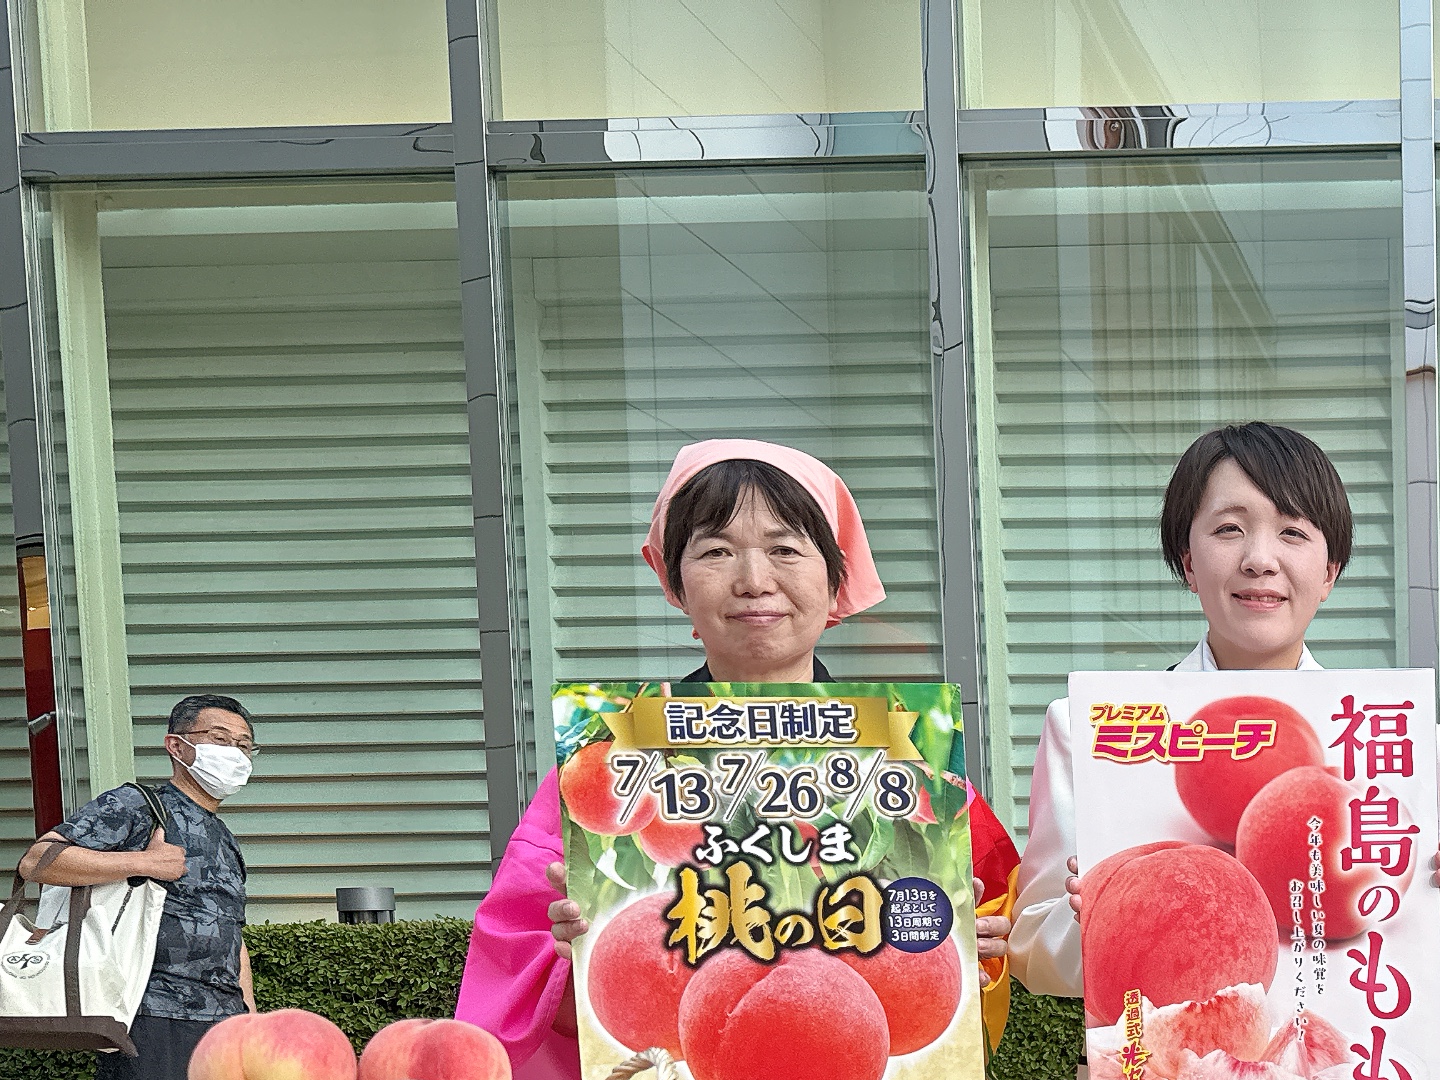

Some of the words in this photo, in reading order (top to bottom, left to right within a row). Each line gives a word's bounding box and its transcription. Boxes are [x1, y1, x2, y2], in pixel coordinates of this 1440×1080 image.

[667, 701, 858, 742] 記念日制定
[1090, 703, 1166, 722] プレミアム
[1093, 721, 1277, 763] ミスピーチ
[613, 750, 713, 824] 7/13
[718, 750, 823, 821] 7/26
[829, 749, 918, 820] 8/8
[696, 823, 857, 864] ふくしま
[667, 861, 886, 964] 桃の日
[888, 889, 937, 902] 7月13日を
[890, 902, 937, 914] 起点として
[1308, 816, 1327, 995] 今年も美味しい夏の味覚を
[888, 915, 942, 928] 13日周期で
[891, 929, 940, 942] 3日間制定
[1289, 880, 1308, 1041] お召し上がりください！
